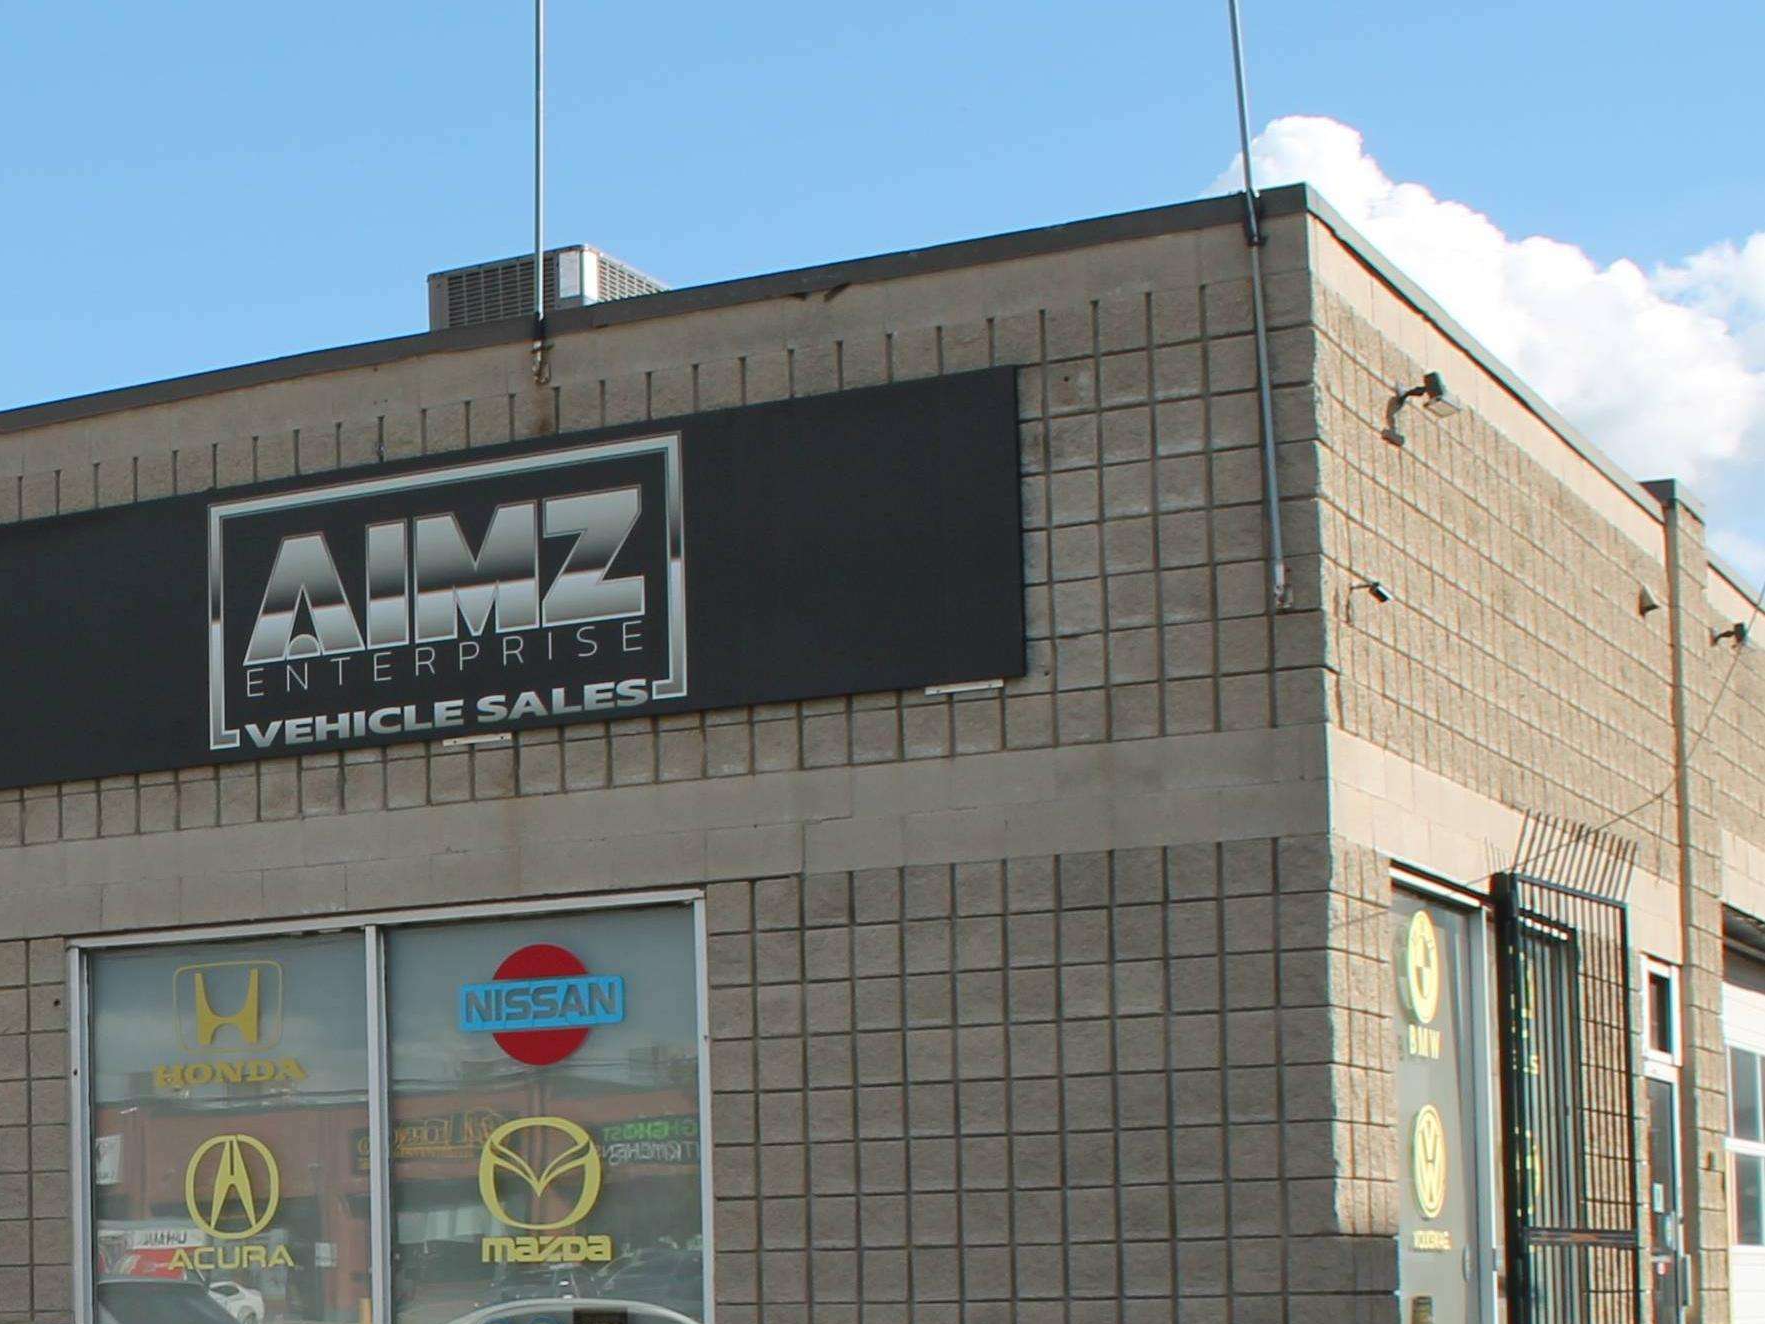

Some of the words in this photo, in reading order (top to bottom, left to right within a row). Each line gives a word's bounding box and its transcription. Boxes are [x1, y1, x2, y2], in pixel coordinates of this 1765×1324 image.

[242, 483, 645, 667] AIMZ
[246, 620, 644, 698] ENTERPRISE
[245, 699, 464, 749] VEHICLE
[476, 678, 650, 724] SALES
[465, 981, 617, 1024] NISSAN
[154, 1058, 307, 1089] HONDA
[168, 1244, 295, 1270] ACURA
